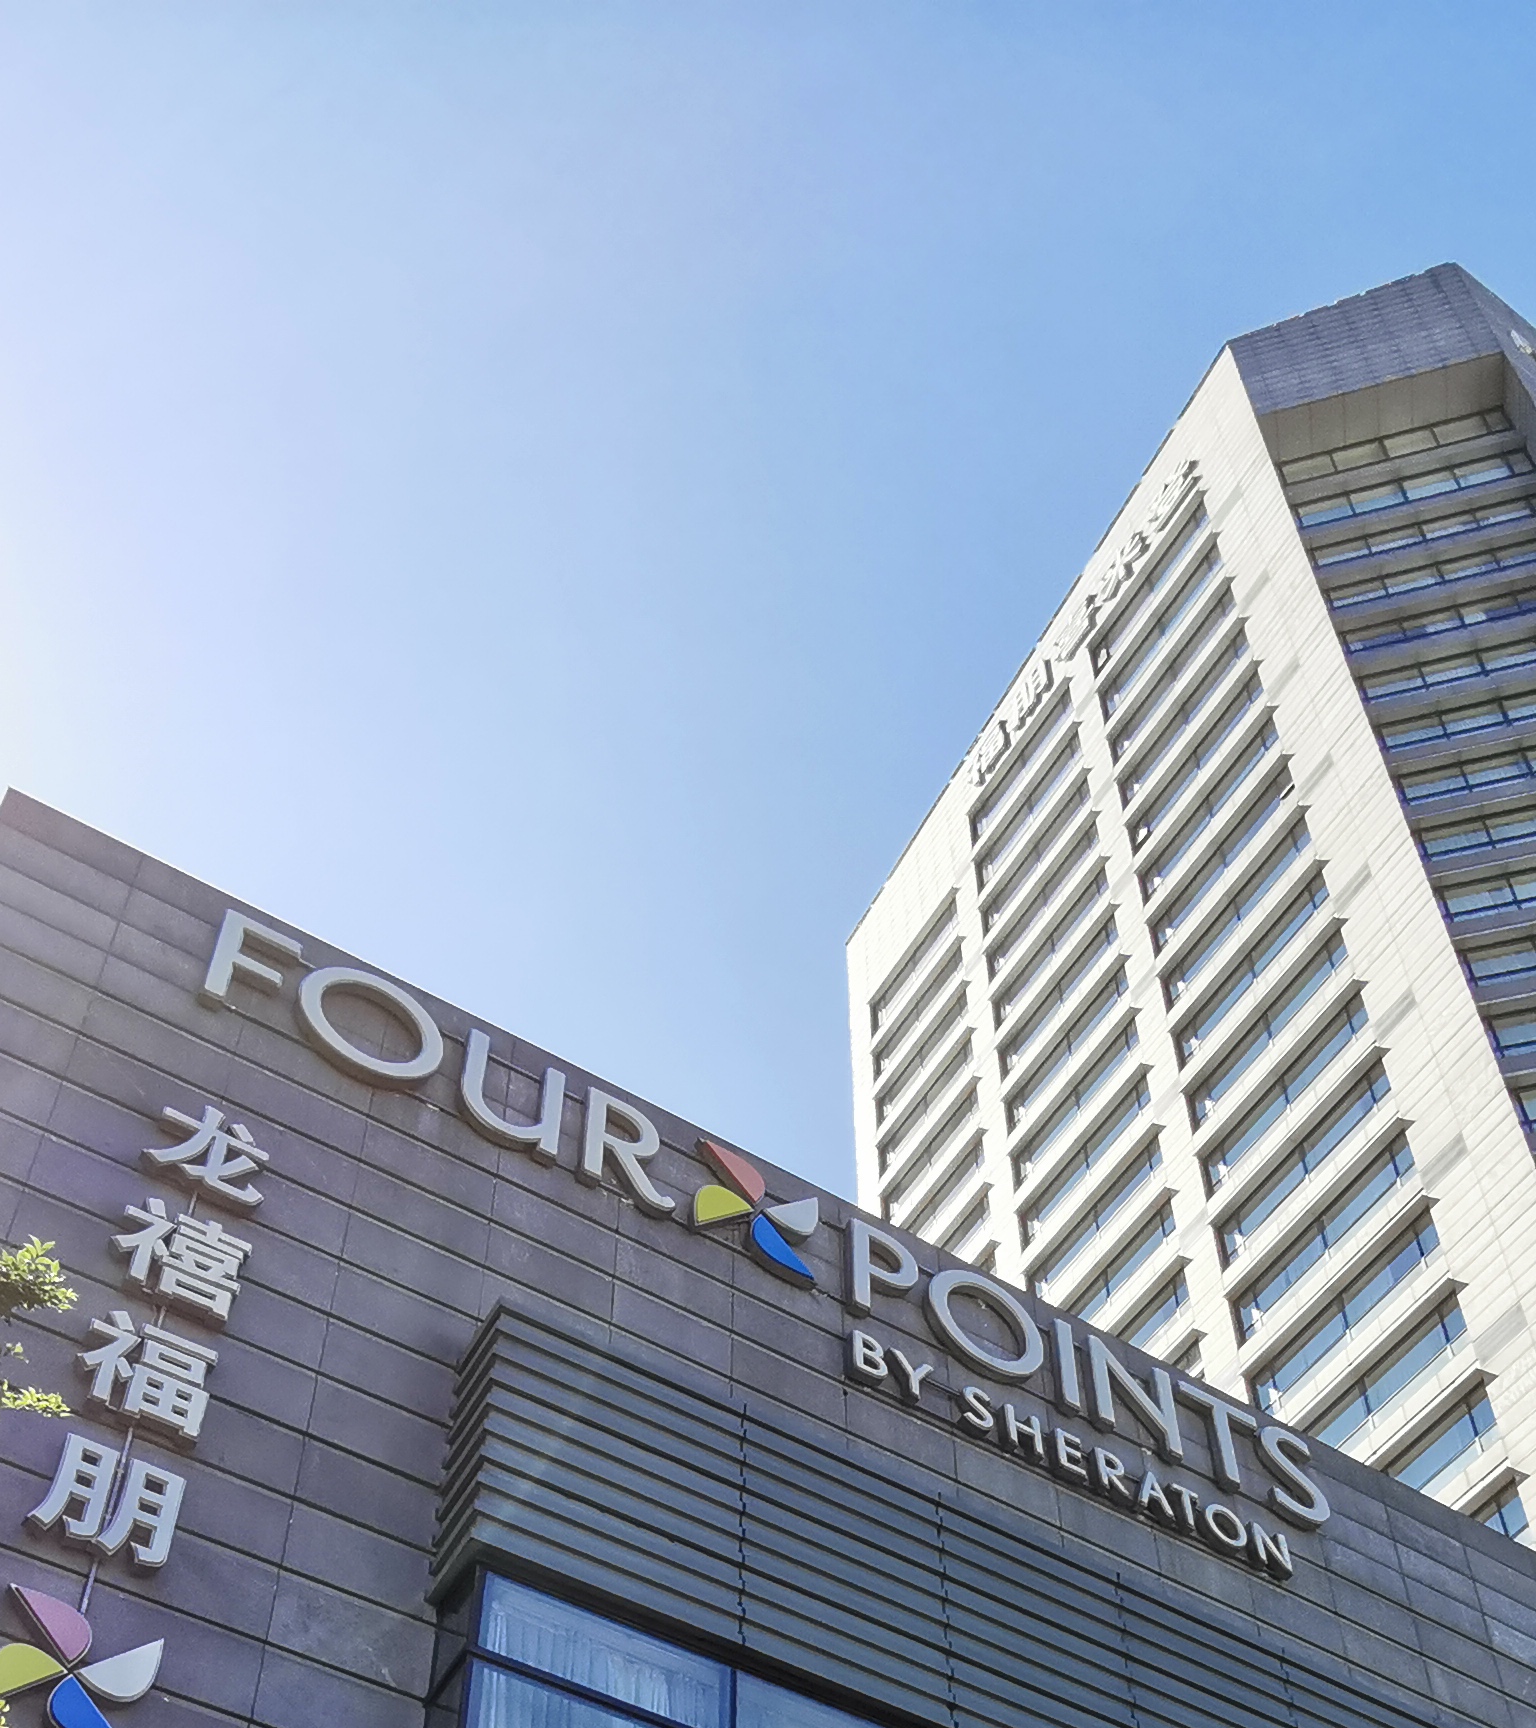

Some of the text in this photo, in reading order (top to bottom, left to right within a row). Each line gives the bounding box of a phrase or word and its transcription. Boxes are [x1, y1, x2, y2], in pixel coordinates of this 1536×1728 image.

[967, 459, 1203, 787] 福朋喜来登
[25, 1103, 270, 1569] 龙禧福朋
[201, 908, 1332, 1531] FOUR POINTS
[848, 1329, 1293, 1580] BY SHERATON
